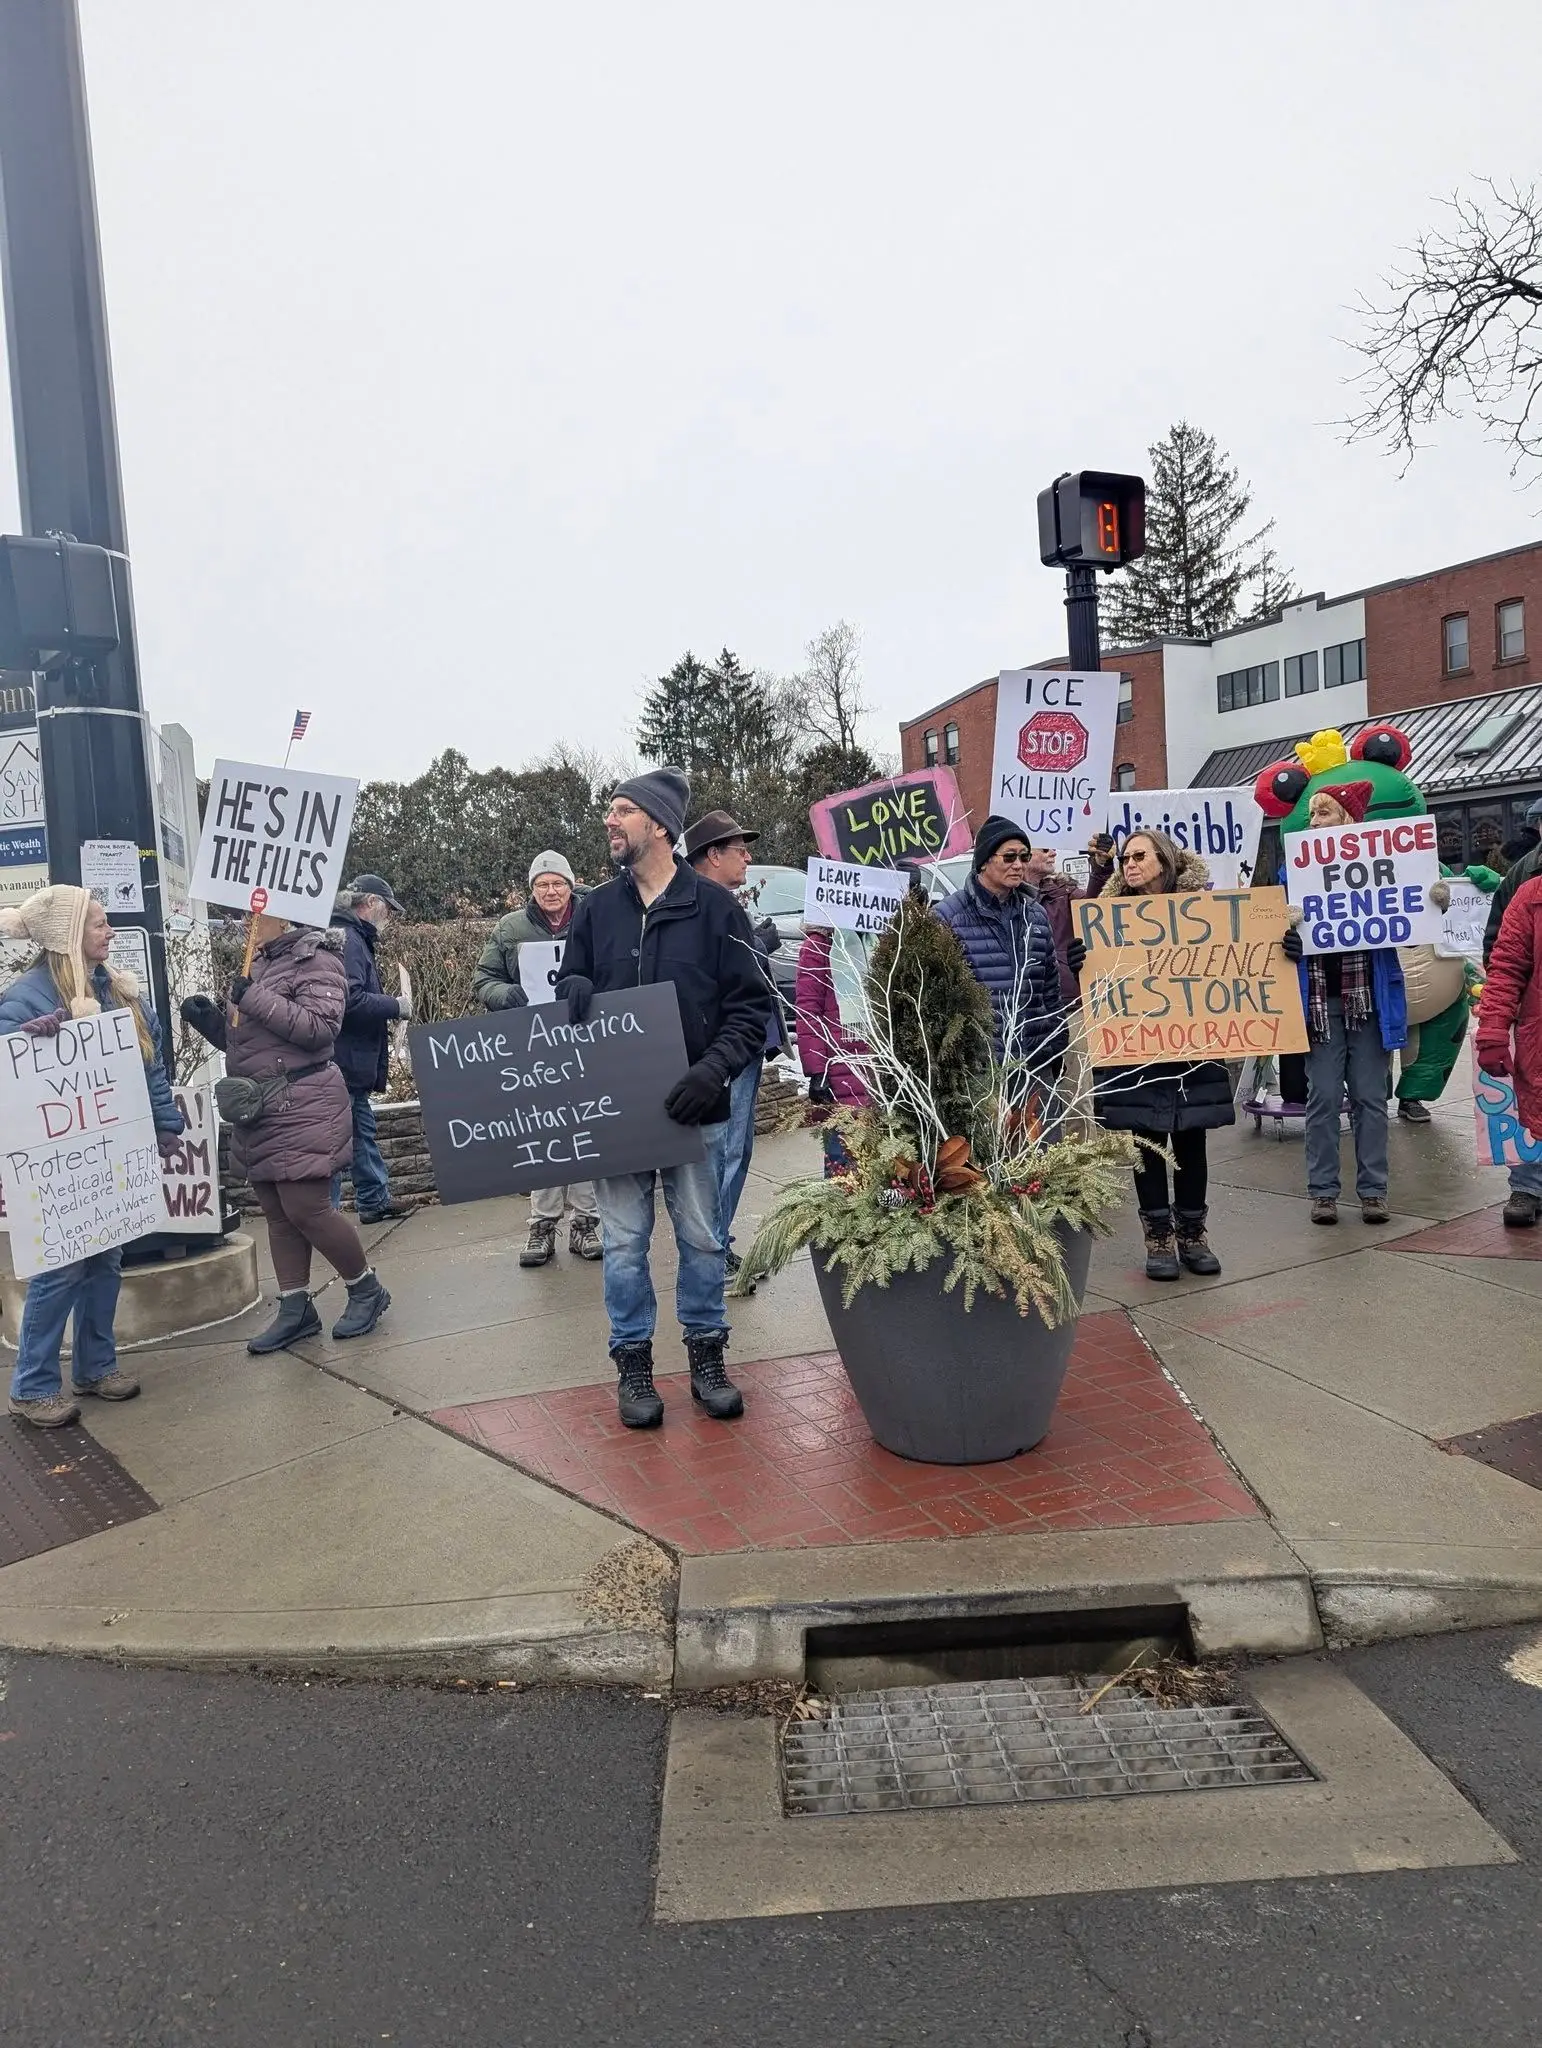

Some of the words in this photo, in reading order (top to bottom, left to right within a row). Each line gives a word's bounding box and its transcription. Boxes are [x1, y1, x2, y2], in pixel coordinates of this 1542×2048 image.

[1025, 678, 1084, 706] ICE
[1025, 731, 1076, 755] STOP
[1000, 773, 1097, 800] KILLING
[216, 778, 289, 838] HE'S
[294, 790, 342, 848] IN
[846, 789, 926, 833] LOVE
[1025, 806, 1074, 834] US!
[11, 838, 41, 850] Wealth
[849, 815, 941, 865] WINS
[1293, 822, 1437, 869] JUSTICE
[210, 835, 257, 885] THE
[255, 843, 329, 898] FILES
[819, 866, 861, 888] LEAVE
[1322, 858, 1396, 892] FOR
[816, 887, 901, 913] GREENLAND
[1302, 885, 1425, 922] RENEE
[855, 913, 893, 933] ALON
[1079, 893, 1251, 951] RESIST
[1311, 916, 1412, 949] GOOD
[1146, 941, 1284, 978] VIOLENCE
[1089, 976, 1284, 1020] RESTORE
[7, 1014, 134, 1079] PEOPLE
[428, 1031, 513, 1069] Make
[527, 1010, 645, 1052] America
[1102, 1017, 1281, 1055] DEMOCRACY
[45, 1067, 117, 1097] WILL
[500, 1049, 586, 1092] Safer!
[36, 1088, 119, 1139] DIE
[448, 1095, 622, 1149] Demilitarize
[6, 1135, 114, 1185] Protect
[512, 1131, 601, 1168] ICE
[38, 1158, 114, 1203] Medicaid
[42, 1185, 113, 1225] Medicare
[126, 1169, 161, 1191] NOAA
[162, 1181, 215, 1218] WW2
[42, 1220, 93, 1246] Clean
[95, 1206, 114, 1225] Air
[121, 1193, 156, 1213] Water
[44, 1233, 93, 1266] SNAP
[99, 1225, 123, 1246] Our
[120, 1210, 156, 1237] Rights
